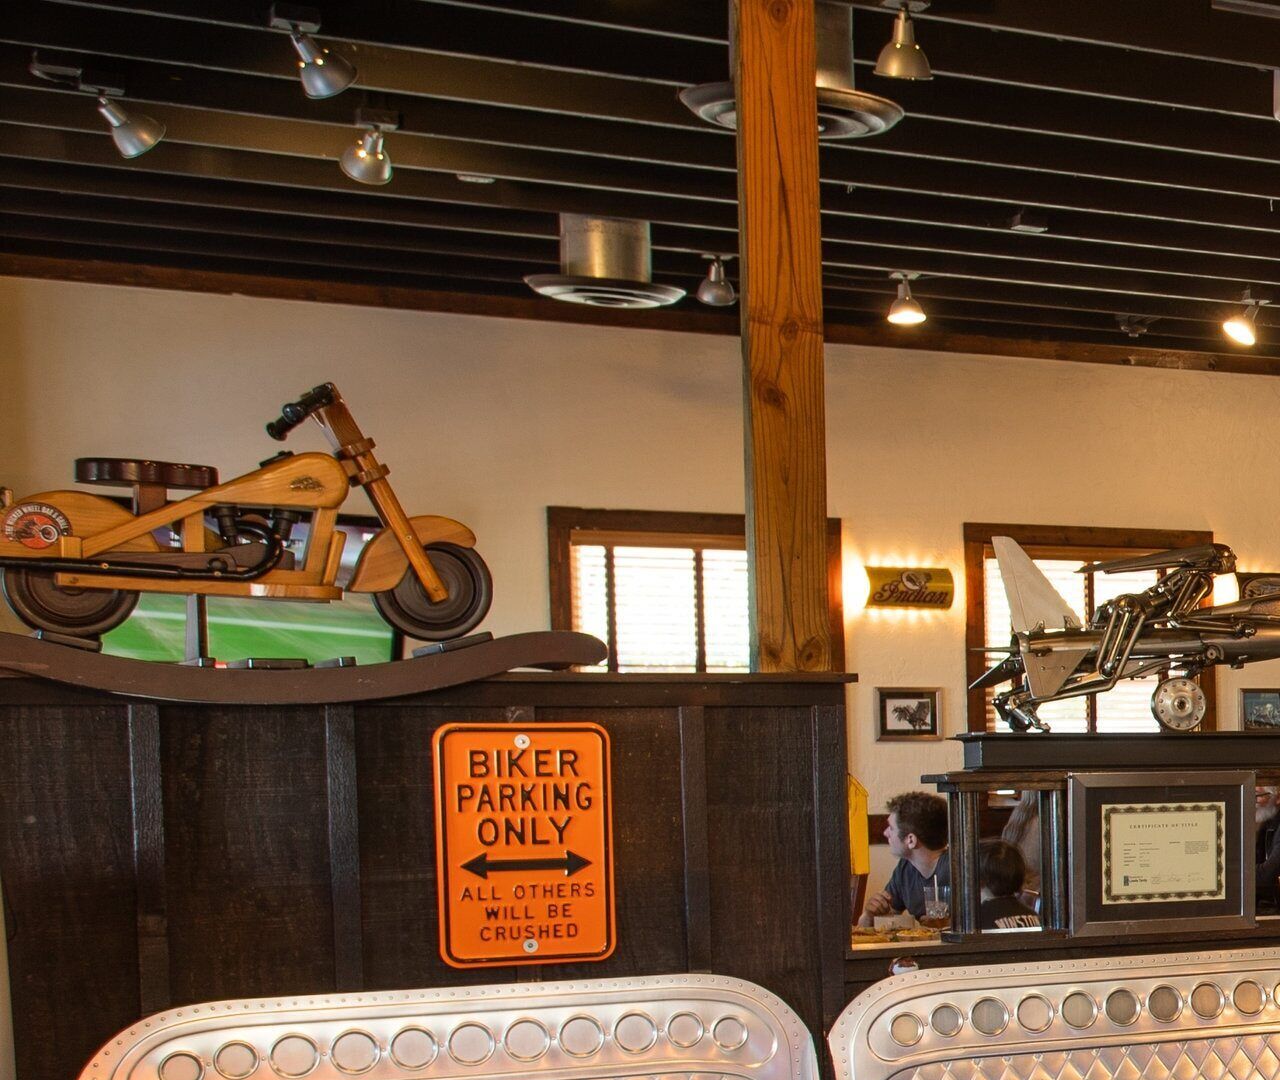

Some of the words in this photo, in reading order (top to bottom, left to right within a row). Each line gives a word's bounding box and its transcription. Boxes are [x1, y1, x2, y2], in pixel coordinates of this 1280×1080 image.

[873, 580, 949, 604] Indian
[468, 749, 579, 778] BIKER
[457, 782, 593, 813] PARKING
[477, 816, 572, 846] ONLY
[461, 886, 502, 901] ALL
[514, 883, 595, 900] OTHERS
[485, 906, 534, 921] WILL
[548, 903, 572, 917] BE
[480, 923, 579, 941] CRUSHED
